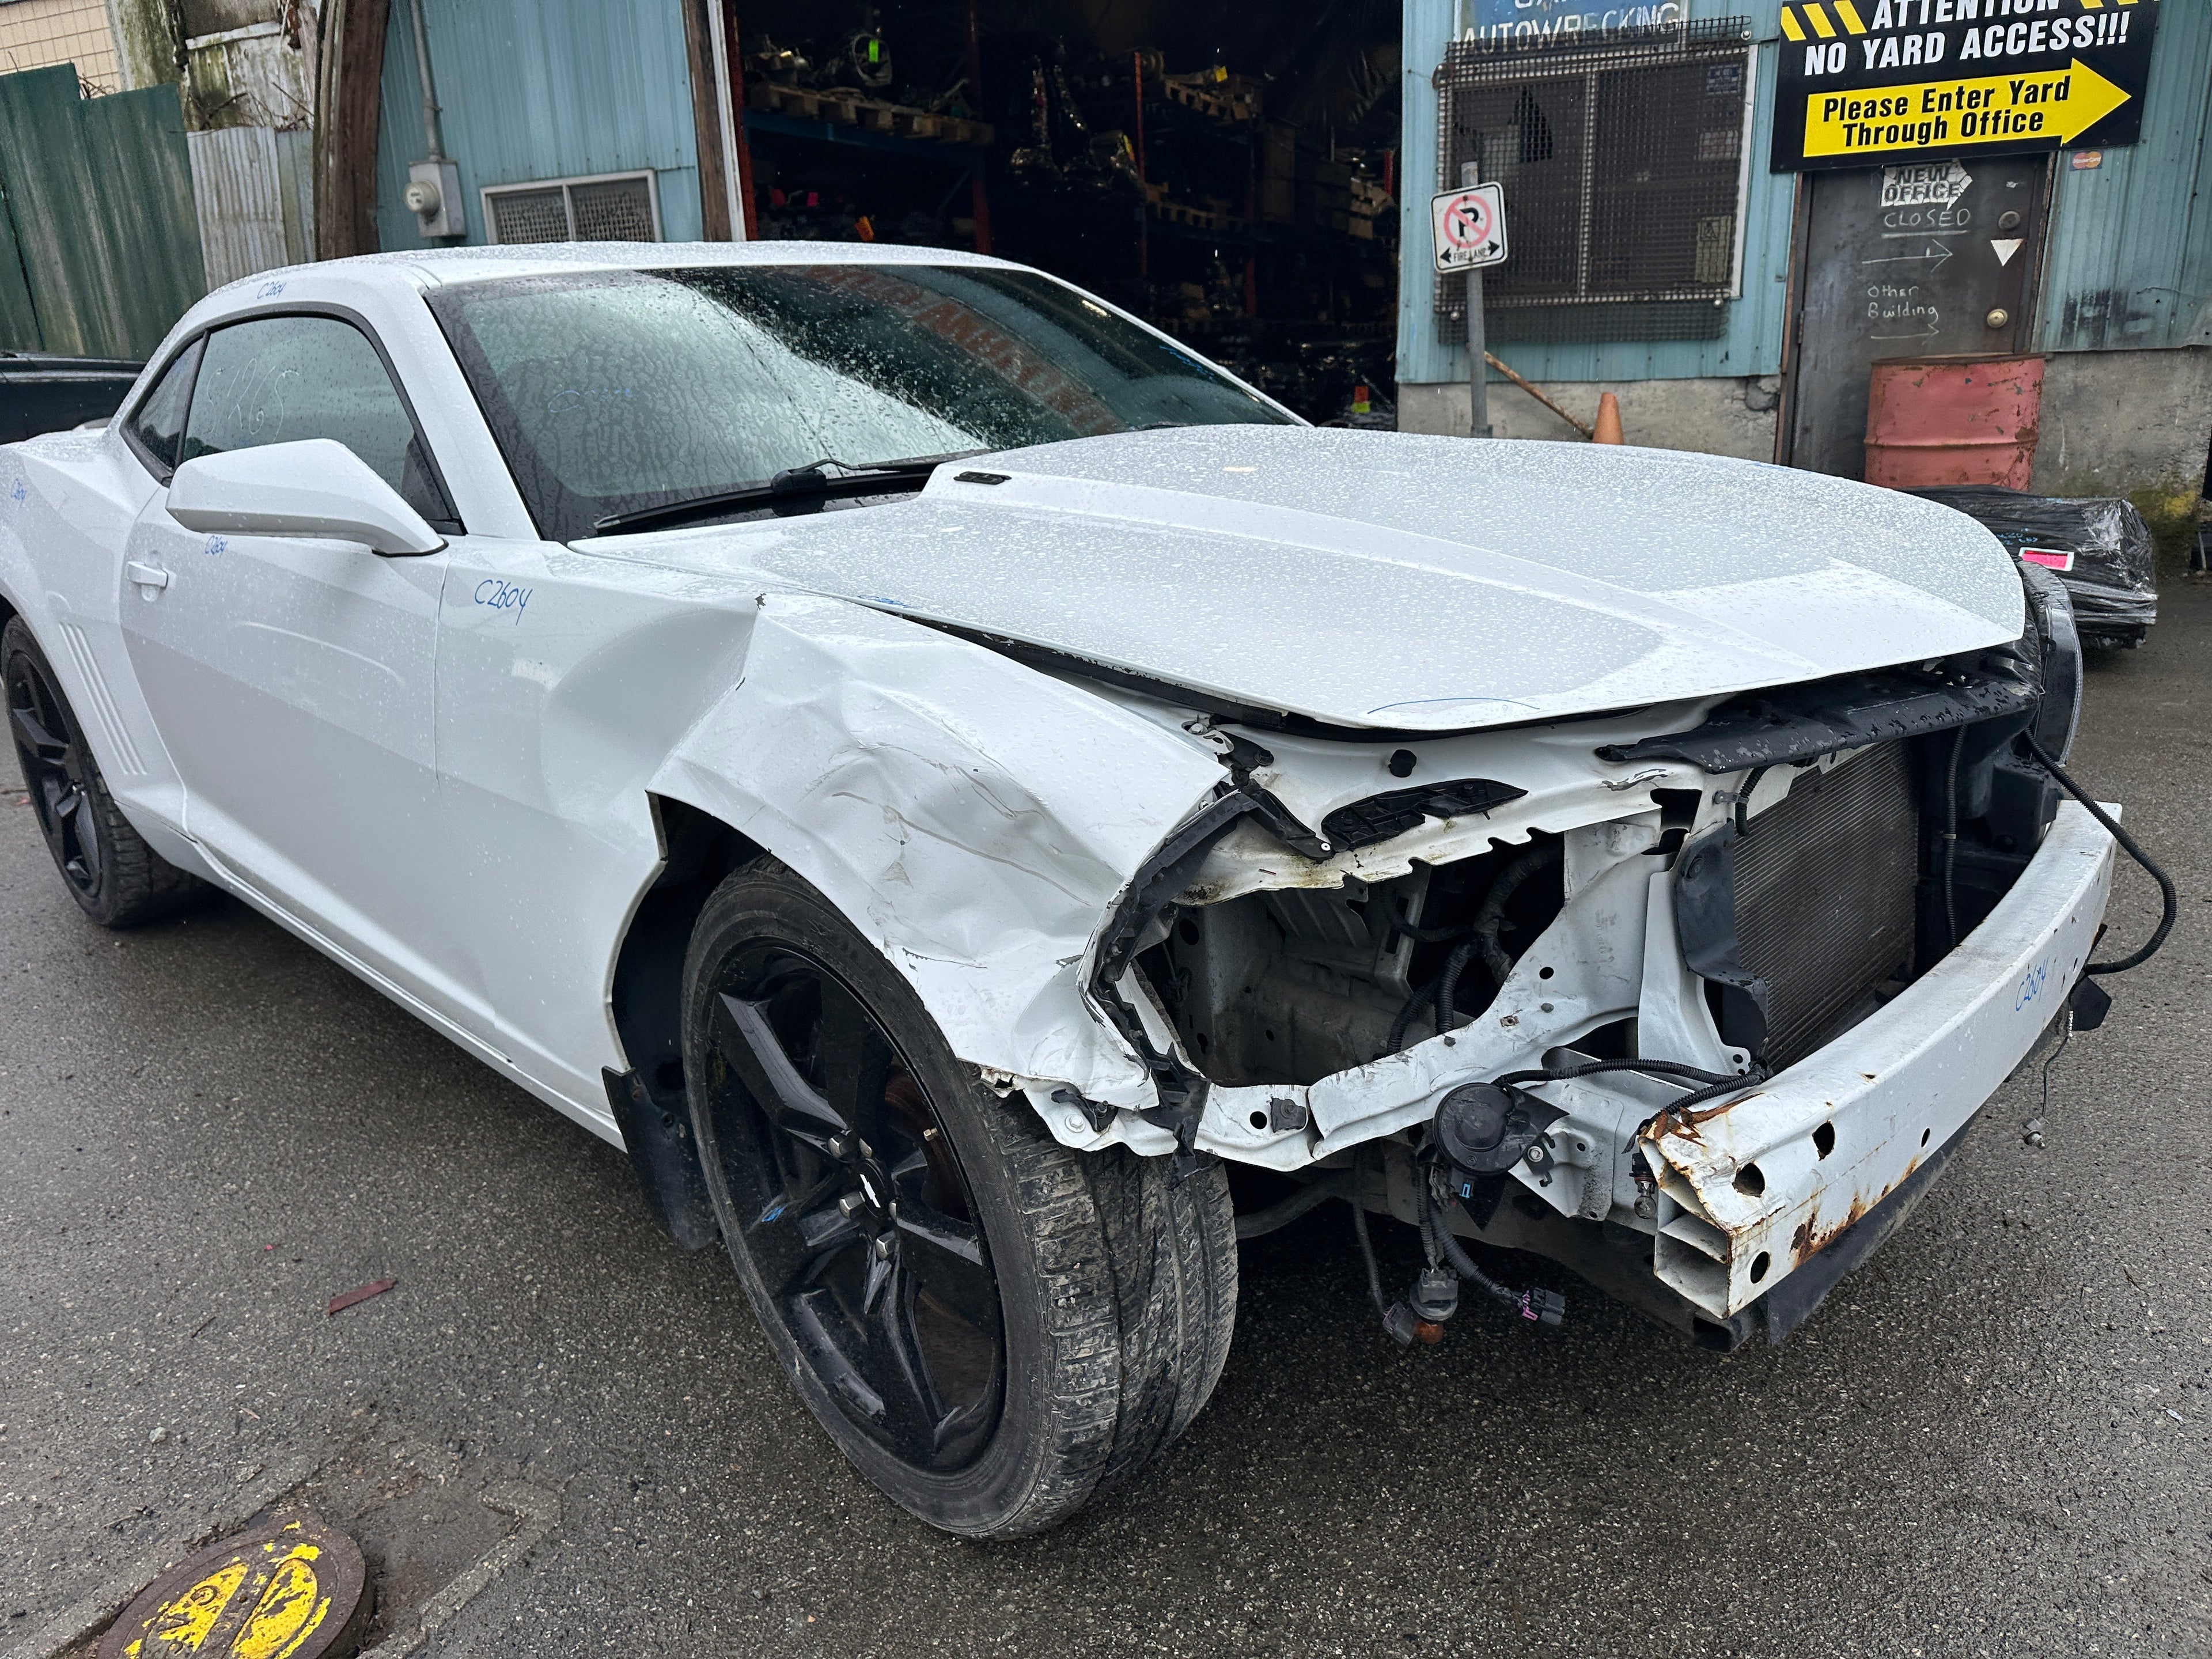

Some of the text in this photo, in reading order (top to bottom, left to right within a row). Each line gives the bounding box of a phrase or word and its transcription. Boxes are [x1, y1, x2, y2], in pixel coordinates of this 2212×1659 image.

[1804, 11, 2130, 76] NO YARD ACCESS!!!
[1823, 75, 2071, 122] Please Enter Yard
[1843, 111, 2044, 147] Through Office
[1897, 165, 1950, 184] NEW
[1884, 182, 1960, 202] OFFICE
[1884, 208, 1971, 228] CLOSED
[1868, 285, 1919, 297] Other
[1868, 301, 1939, 325] Building
[475, 579, 533, 626] C2604
